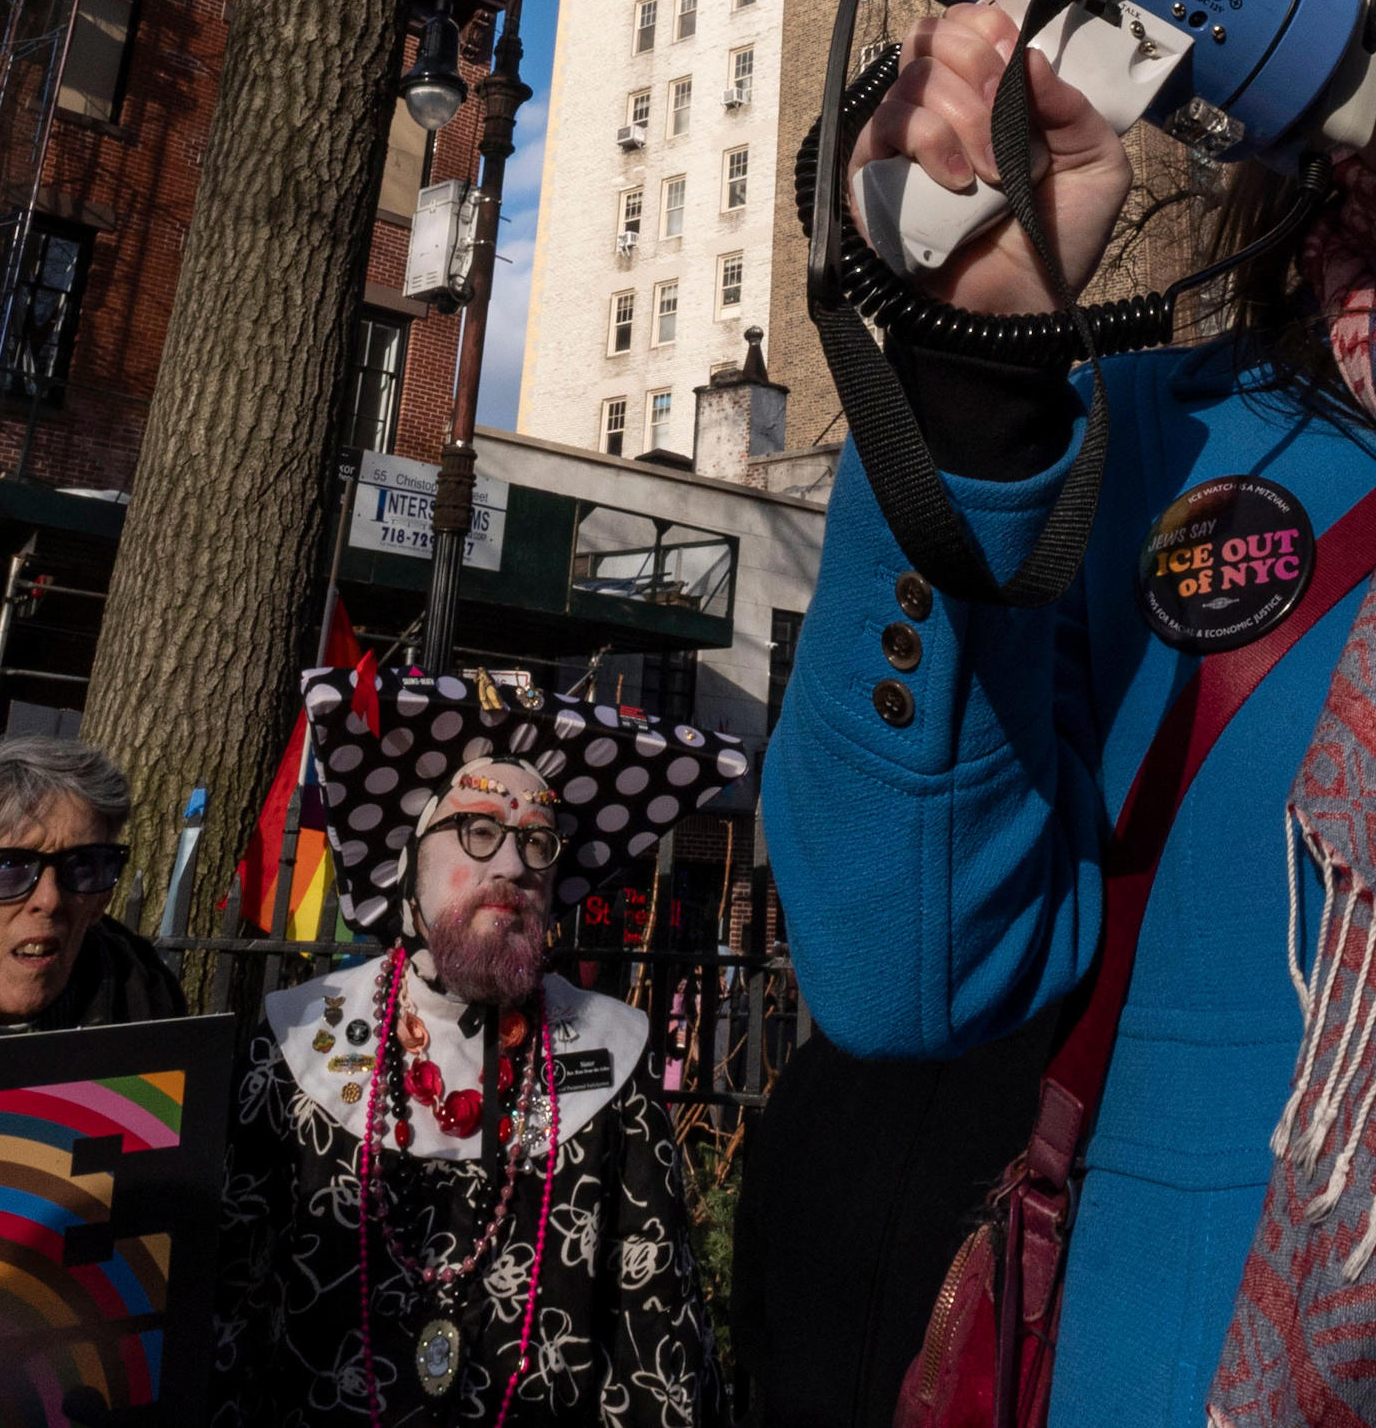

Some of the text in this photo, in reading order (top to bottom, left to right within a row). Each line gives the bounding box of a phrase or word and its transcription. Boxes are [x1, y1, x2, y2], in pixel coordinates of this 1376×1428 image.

[374, 469, 387, 482] 55
[396, 474, 438, 494] Christop
[1187, 492, 1203, 504] ICE
[1147, 518, 1217, 553] JEWS SAY
[1156, 528, 1300, 577] ICE OUT
[1178, 555, 1300, 598] of NYC
[1204, 618, 1253, 638] ECONOMIC
[1253, 593, 1283, 625] JUSTICE
